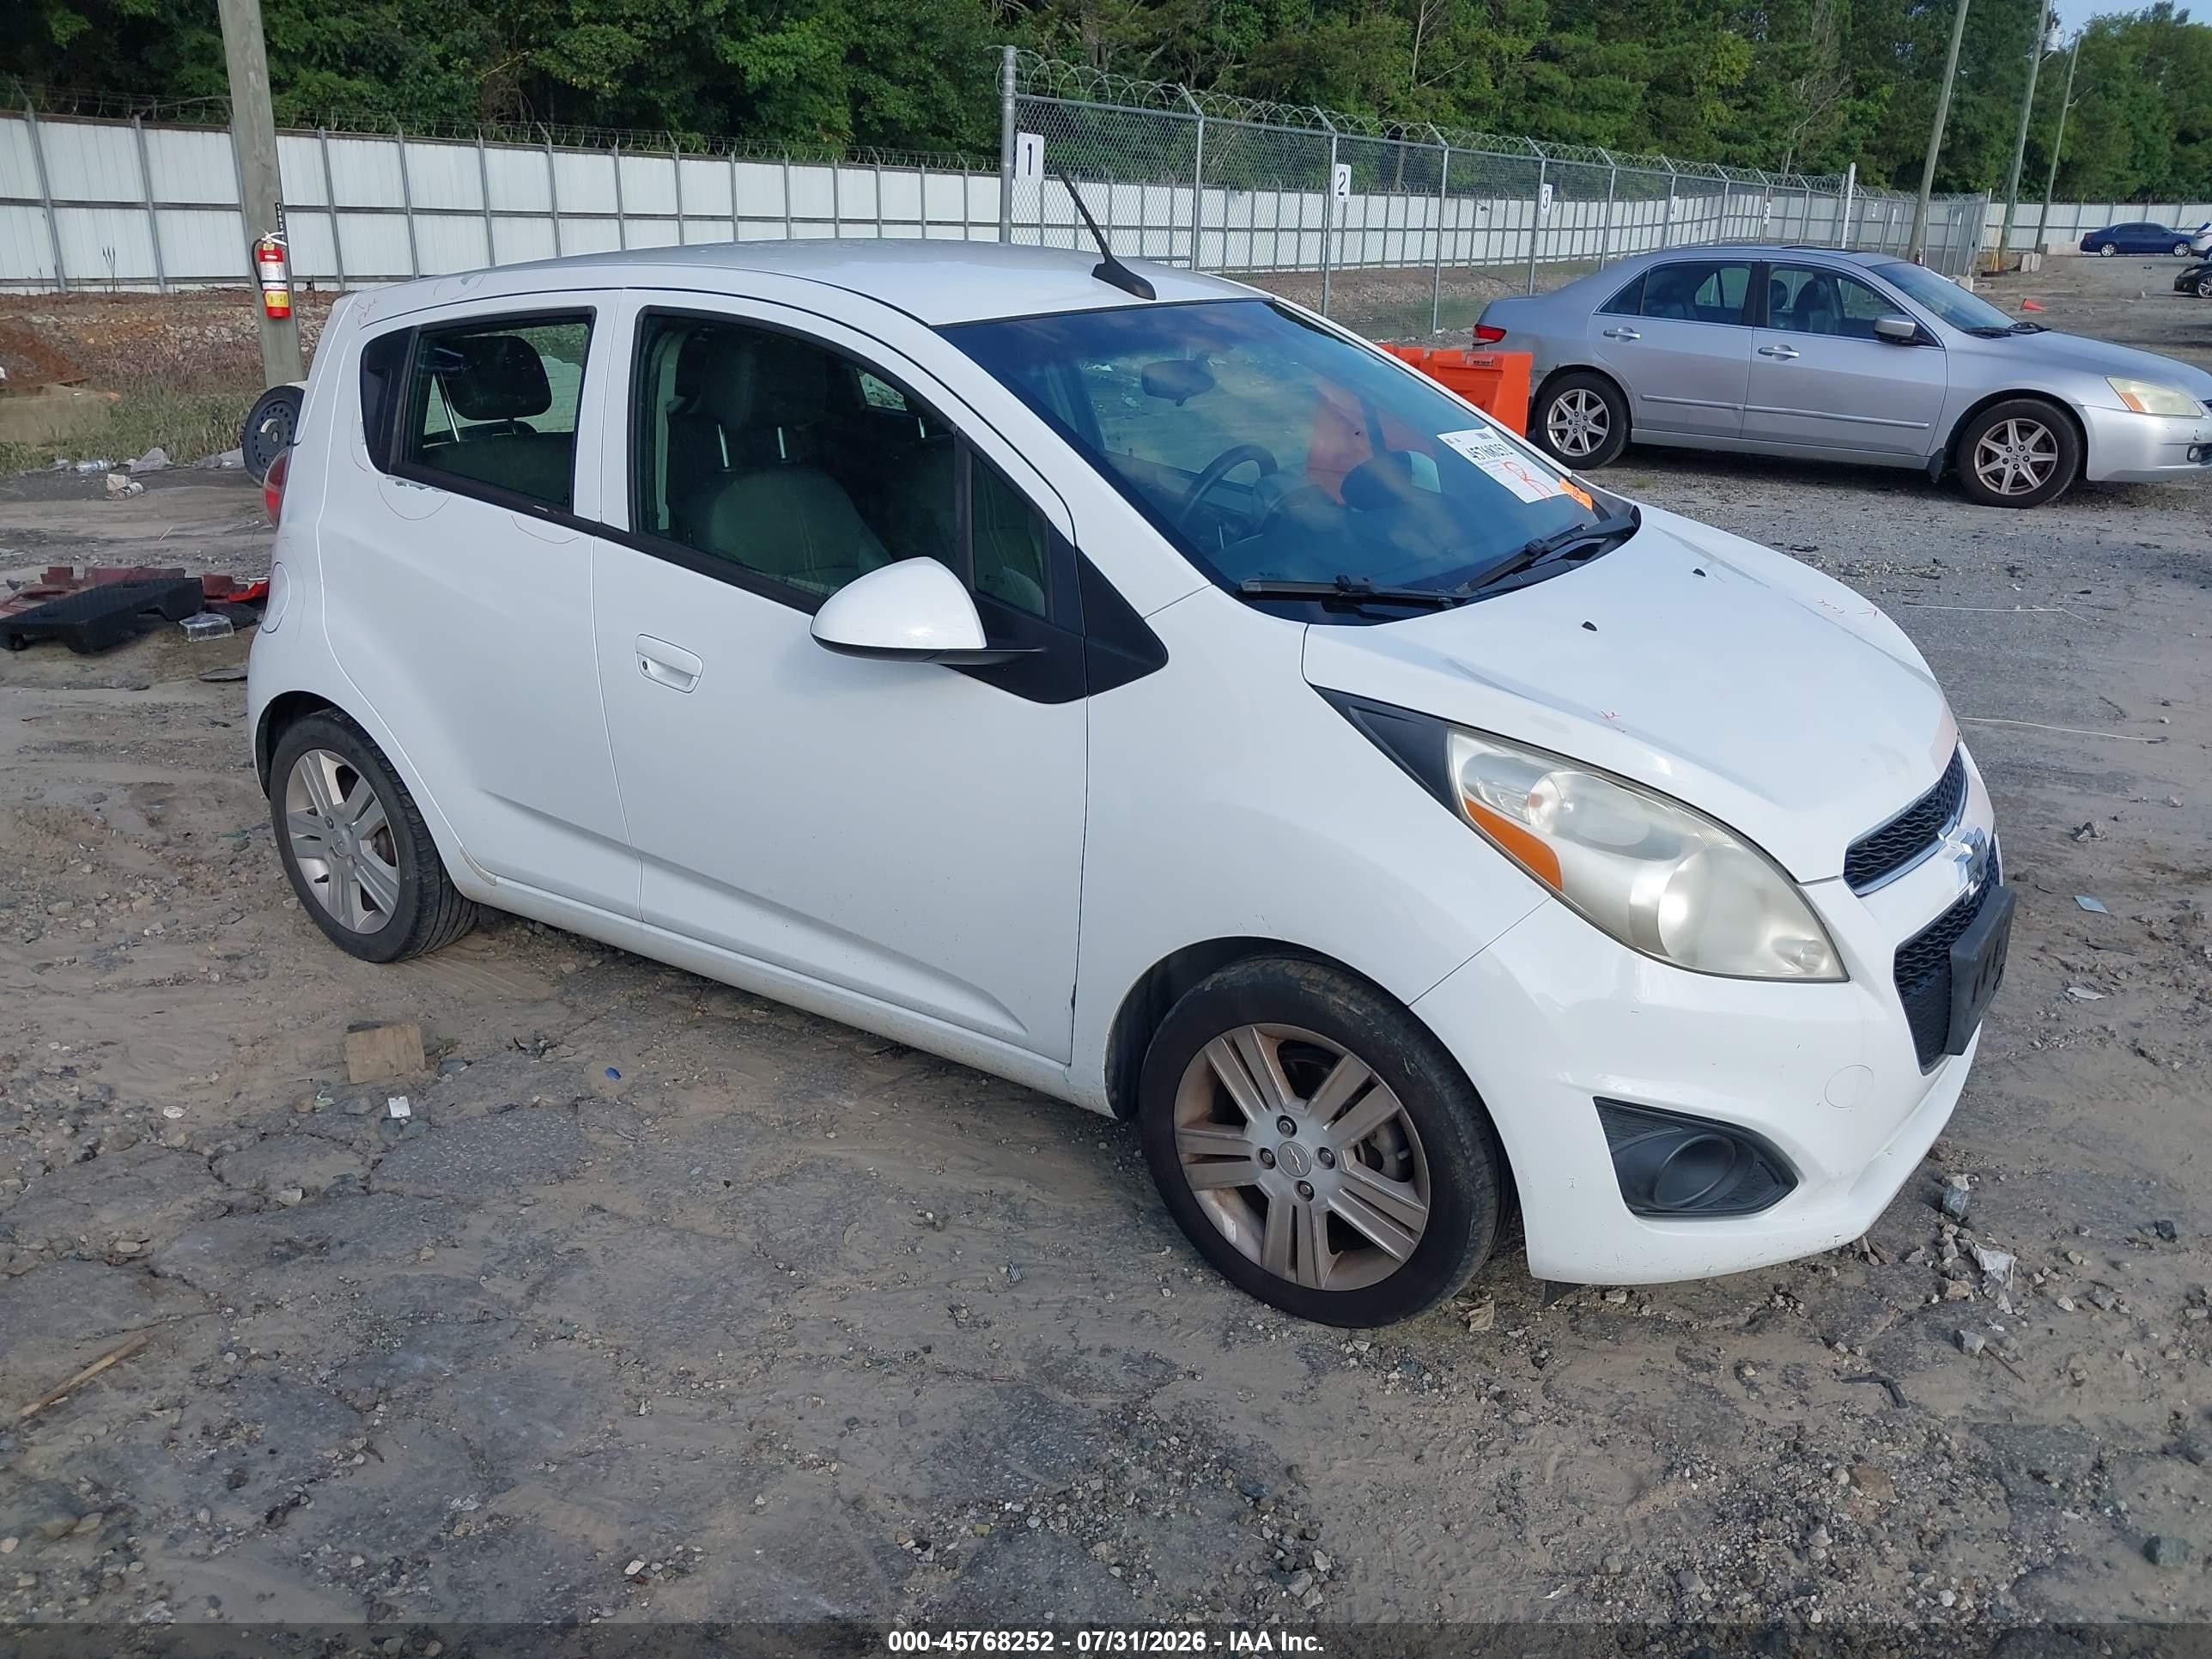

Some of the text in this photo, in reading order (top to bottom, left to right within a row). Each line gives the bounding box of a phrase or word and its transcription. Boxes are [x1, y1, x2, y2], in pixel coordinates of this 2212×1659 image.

[1027, 142, 1033, 177] 1
[1338, 170, 1347, 197] 2
[1542, 189, 1549, 210] 3
